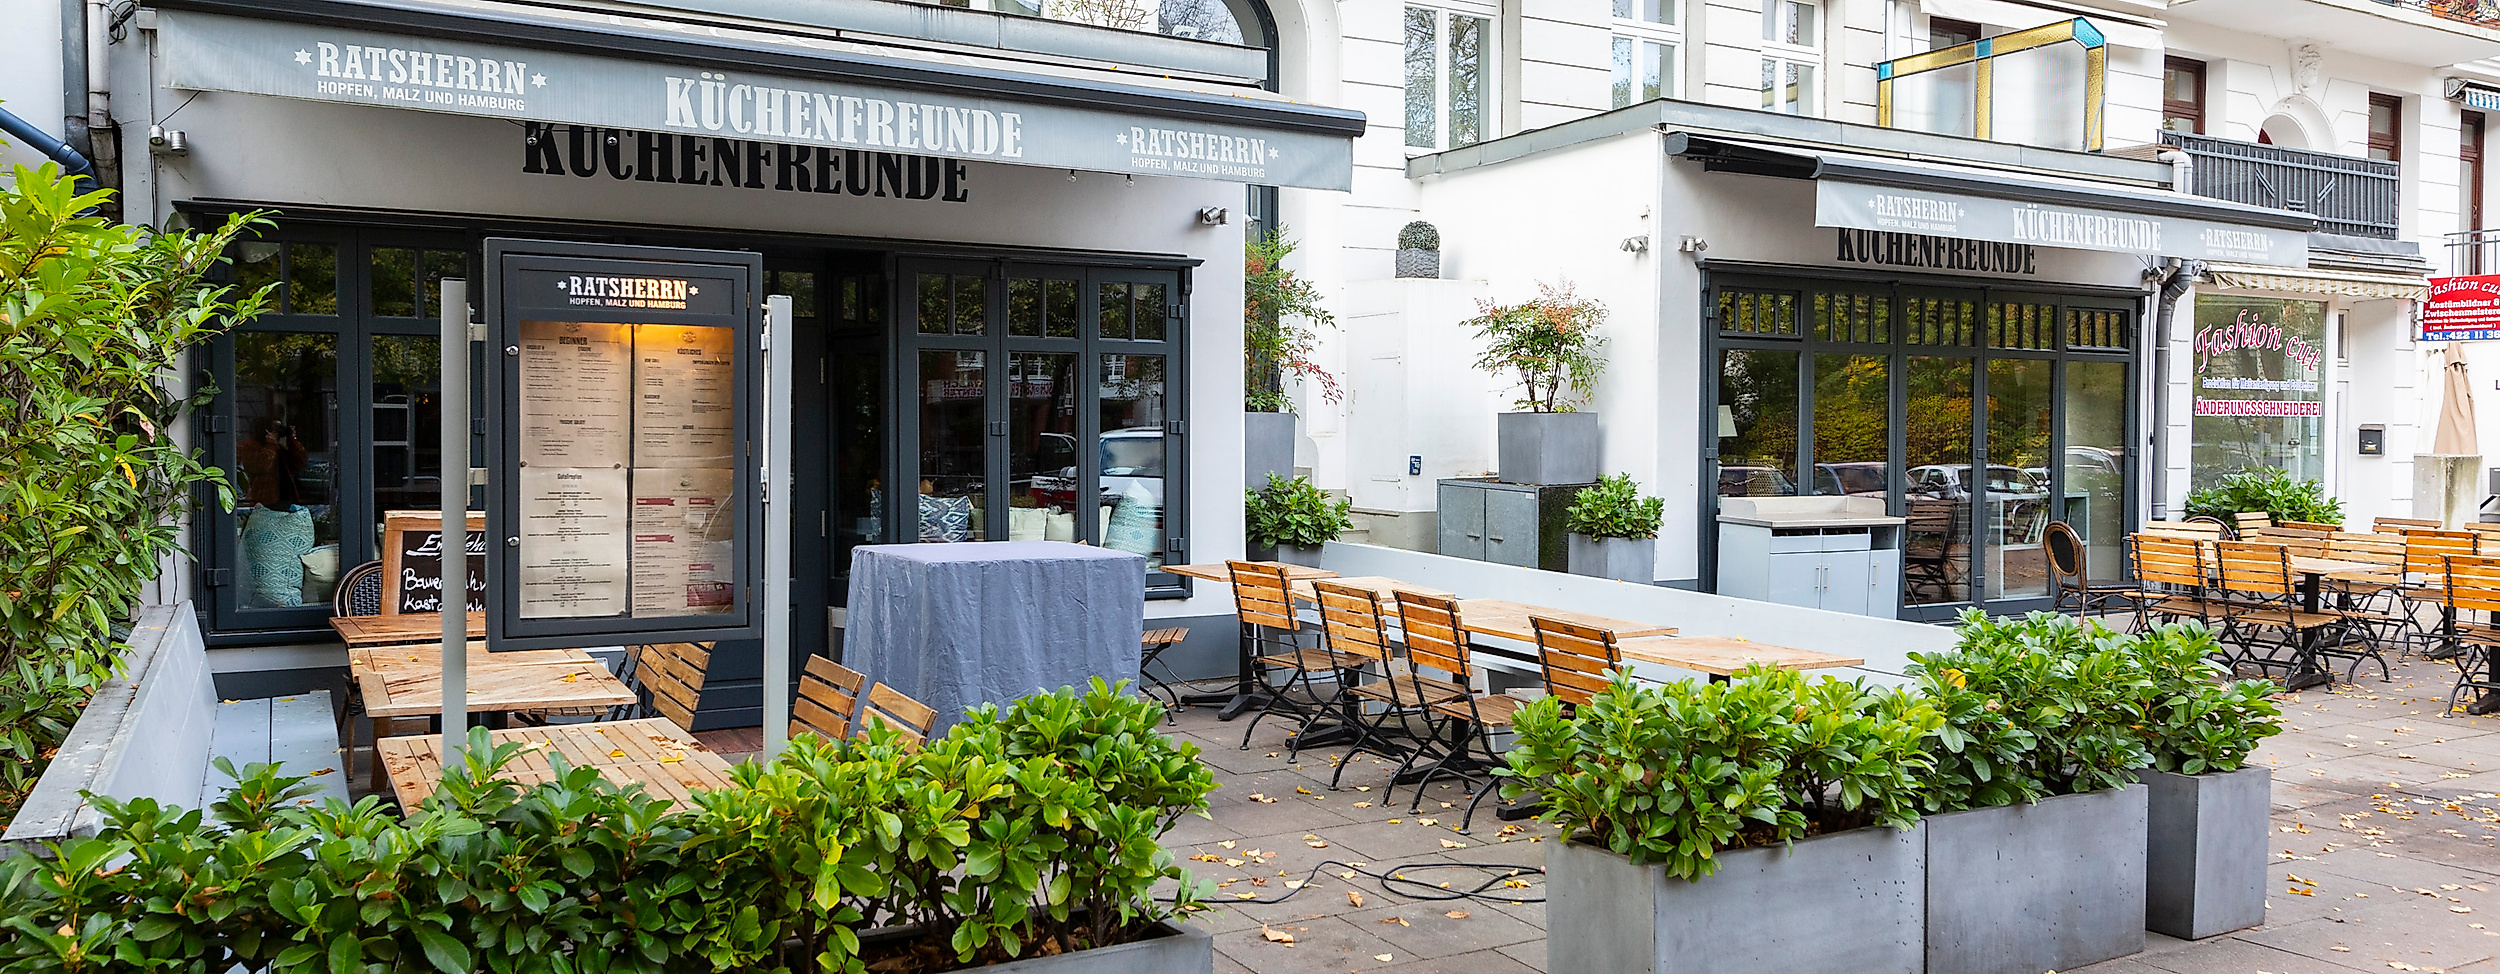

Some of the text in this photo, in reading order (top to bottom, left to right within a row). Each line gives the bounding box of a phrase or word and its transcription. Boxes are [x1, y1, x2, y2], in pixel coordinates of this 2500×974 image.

[317, 42, 526, 95] RATSHERRN
[317, 80, 525, 111] HOPFEN, MALZ UND HAMBURG
[665, 72, 1022, 158] KÜCHENFREUNDE
[1131, 126, 1266, 166] RATSHERRN
[1131, 157, 1265, 178] HOPFEN, MALZ UND HAMBURG
[1876, 194, 1957, 223] RATSHERRN
[1877, 217, 1957, 233] HOPFEN, MALZ UND HAMBURG
[2013, 203, 2162, 251] KÜCHENFREUNDE
[2206, 228, 2268, 252] RATSHERRN
[569, 276, 688, 300] RATSHERRN
[570, 297, 687, 310] HOPFEN, MALZ UND HAMBURG
[2429, 299, 2491, 309] Kostümbildner
[2195, 309, 2322, 373] Fashion cut
[2195, 396, 2322, 416] ÄNDERUNGSSCHNEIDEREI
